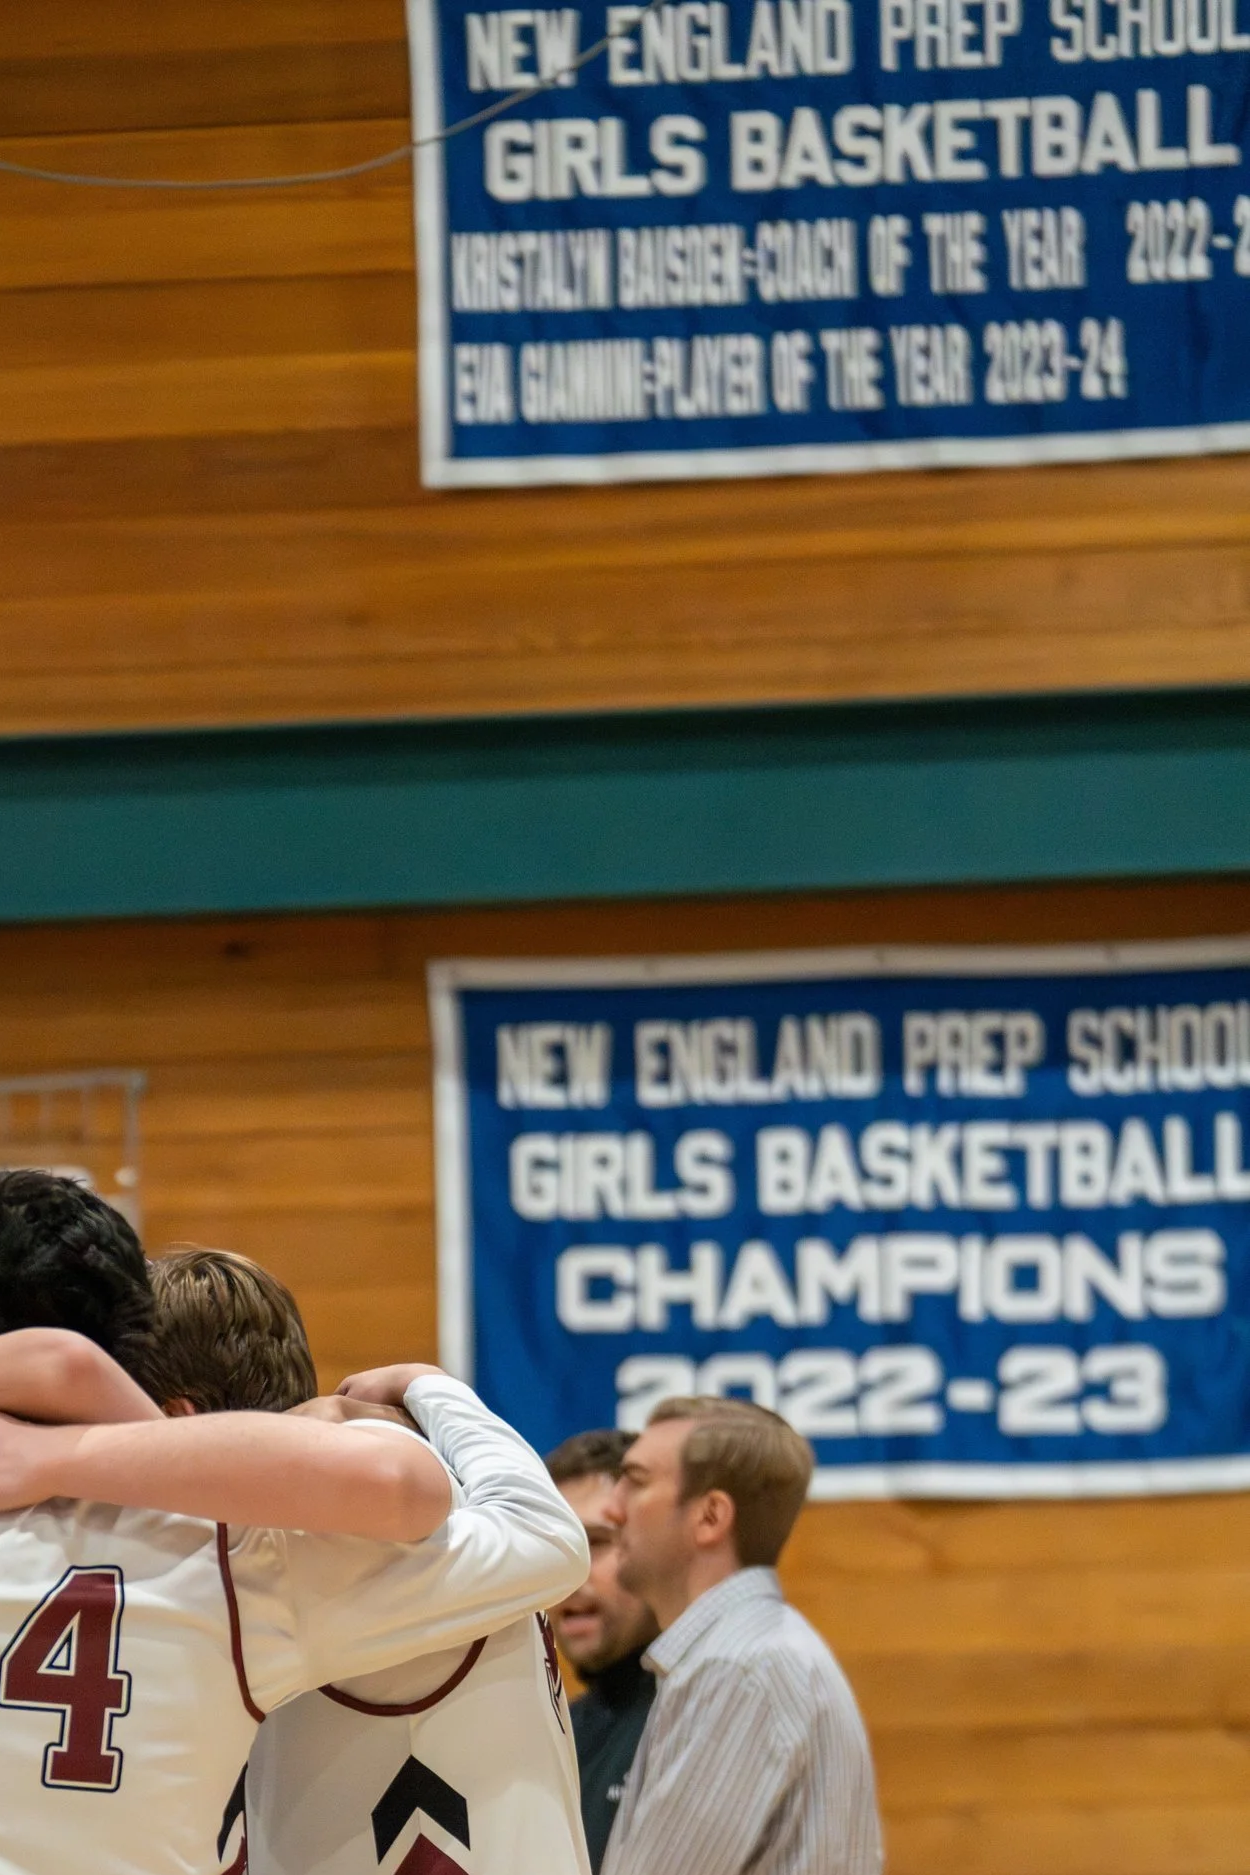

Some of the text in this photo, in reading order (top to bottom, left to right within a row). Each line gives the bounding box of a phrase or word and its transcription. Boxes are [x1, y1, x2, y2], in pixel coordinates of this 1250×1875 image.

[466, 0, 1250, 91] NEW ENGLAND PREP SCHOOL
[484, 84, 1240, 202] GIRLS BASKETBALL
[869, 215, 910, 296] OF
[923, 211, 986, 293] THE
[1002, 207, 1085, 290] YEAR
[454, 343, 515, 425] EVA
[771, 330, 814, 413] OF
[820, 327, 882, 410] THE
[890, 324, 971, 406] YEAR
[983, 317, 1127, 404] 2023-24
[497, 1023, 611, 1109] NEW
[635, 1013, 882, 1108] ENGLAND
[903, 1010, 1045, 1098] PREP
[510, 1112, 1250, 1221] GIRLS BASKETBALL
[556, 1229, 1226, 1333] CHAMPIONS
